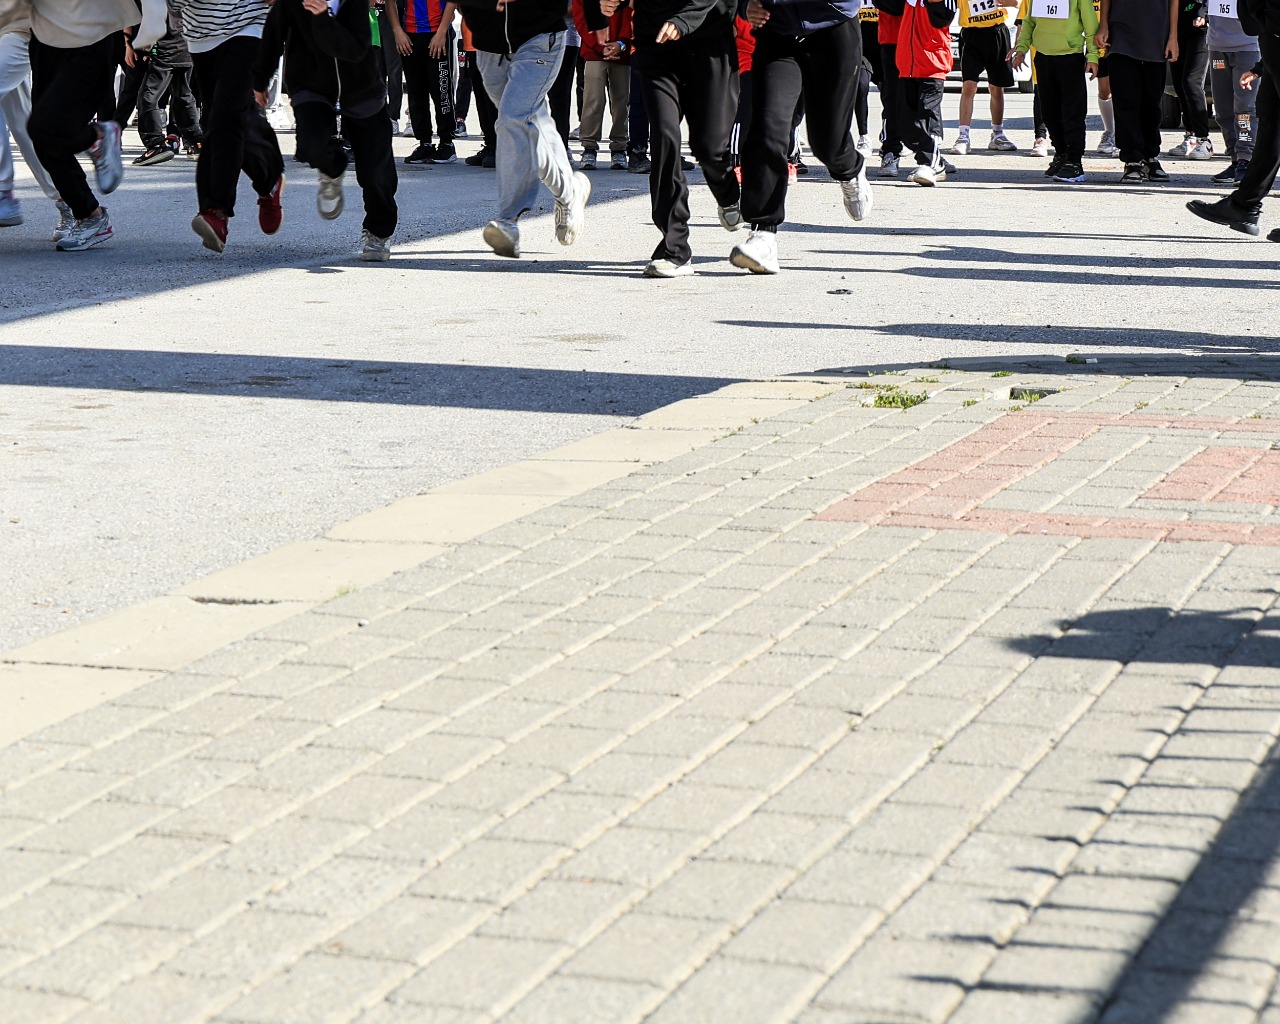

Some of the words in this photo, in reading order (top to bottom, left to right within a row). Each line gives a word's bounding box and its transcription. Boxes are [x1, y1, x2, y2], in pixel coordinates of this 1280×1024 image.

[972, 0, 995, 12] 112
[1046, 5, 1058, 15] 161
[1219, 4, 1231, 14] 165
[438, 61, 451, 115] LACOSTE
